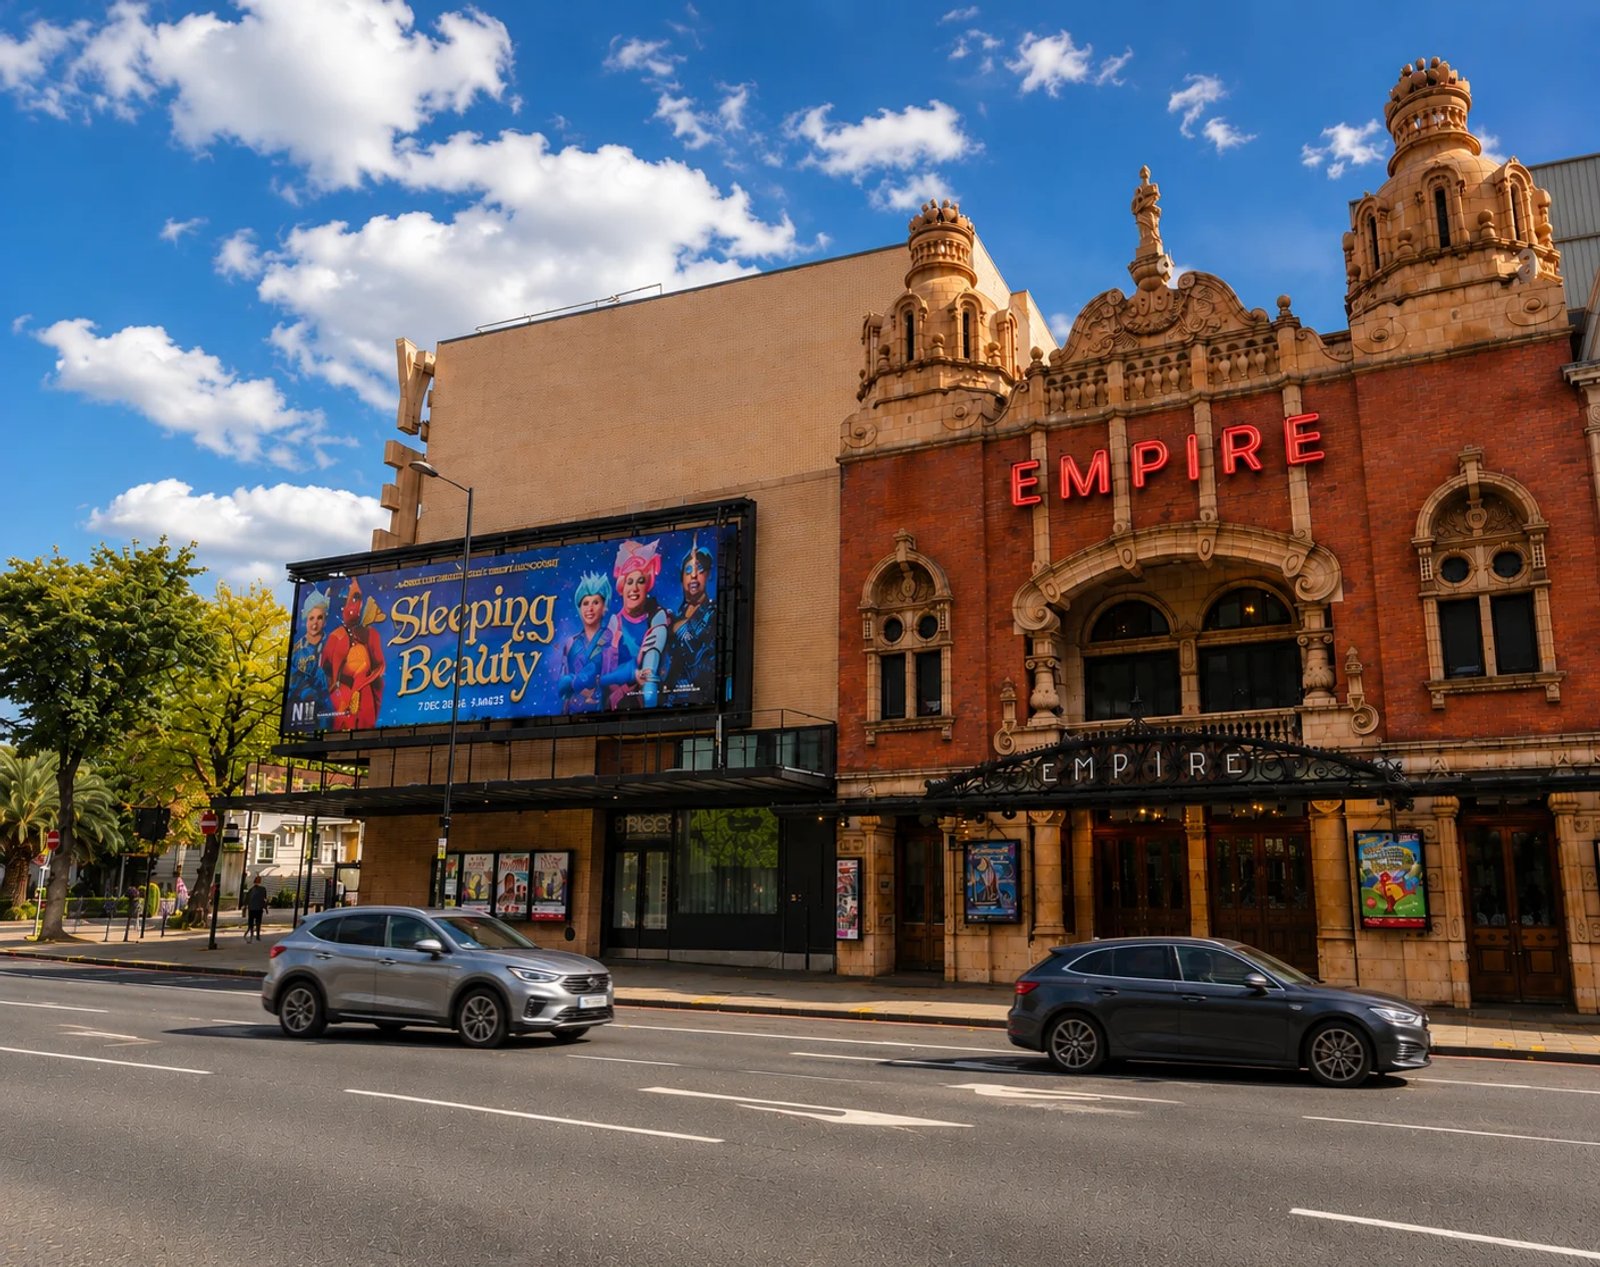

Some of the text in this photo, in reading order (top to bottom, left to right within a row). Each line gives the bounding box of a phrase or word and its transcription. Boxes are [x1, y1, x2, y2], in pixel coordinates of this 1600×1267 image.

[1010, 412, 1325, 507] EMPIRE
[386, 585, 558, 647] Sleeping
[397, 640, 543, 703] Beauty
[1042, 751, 1243, 782] EMPIRE
